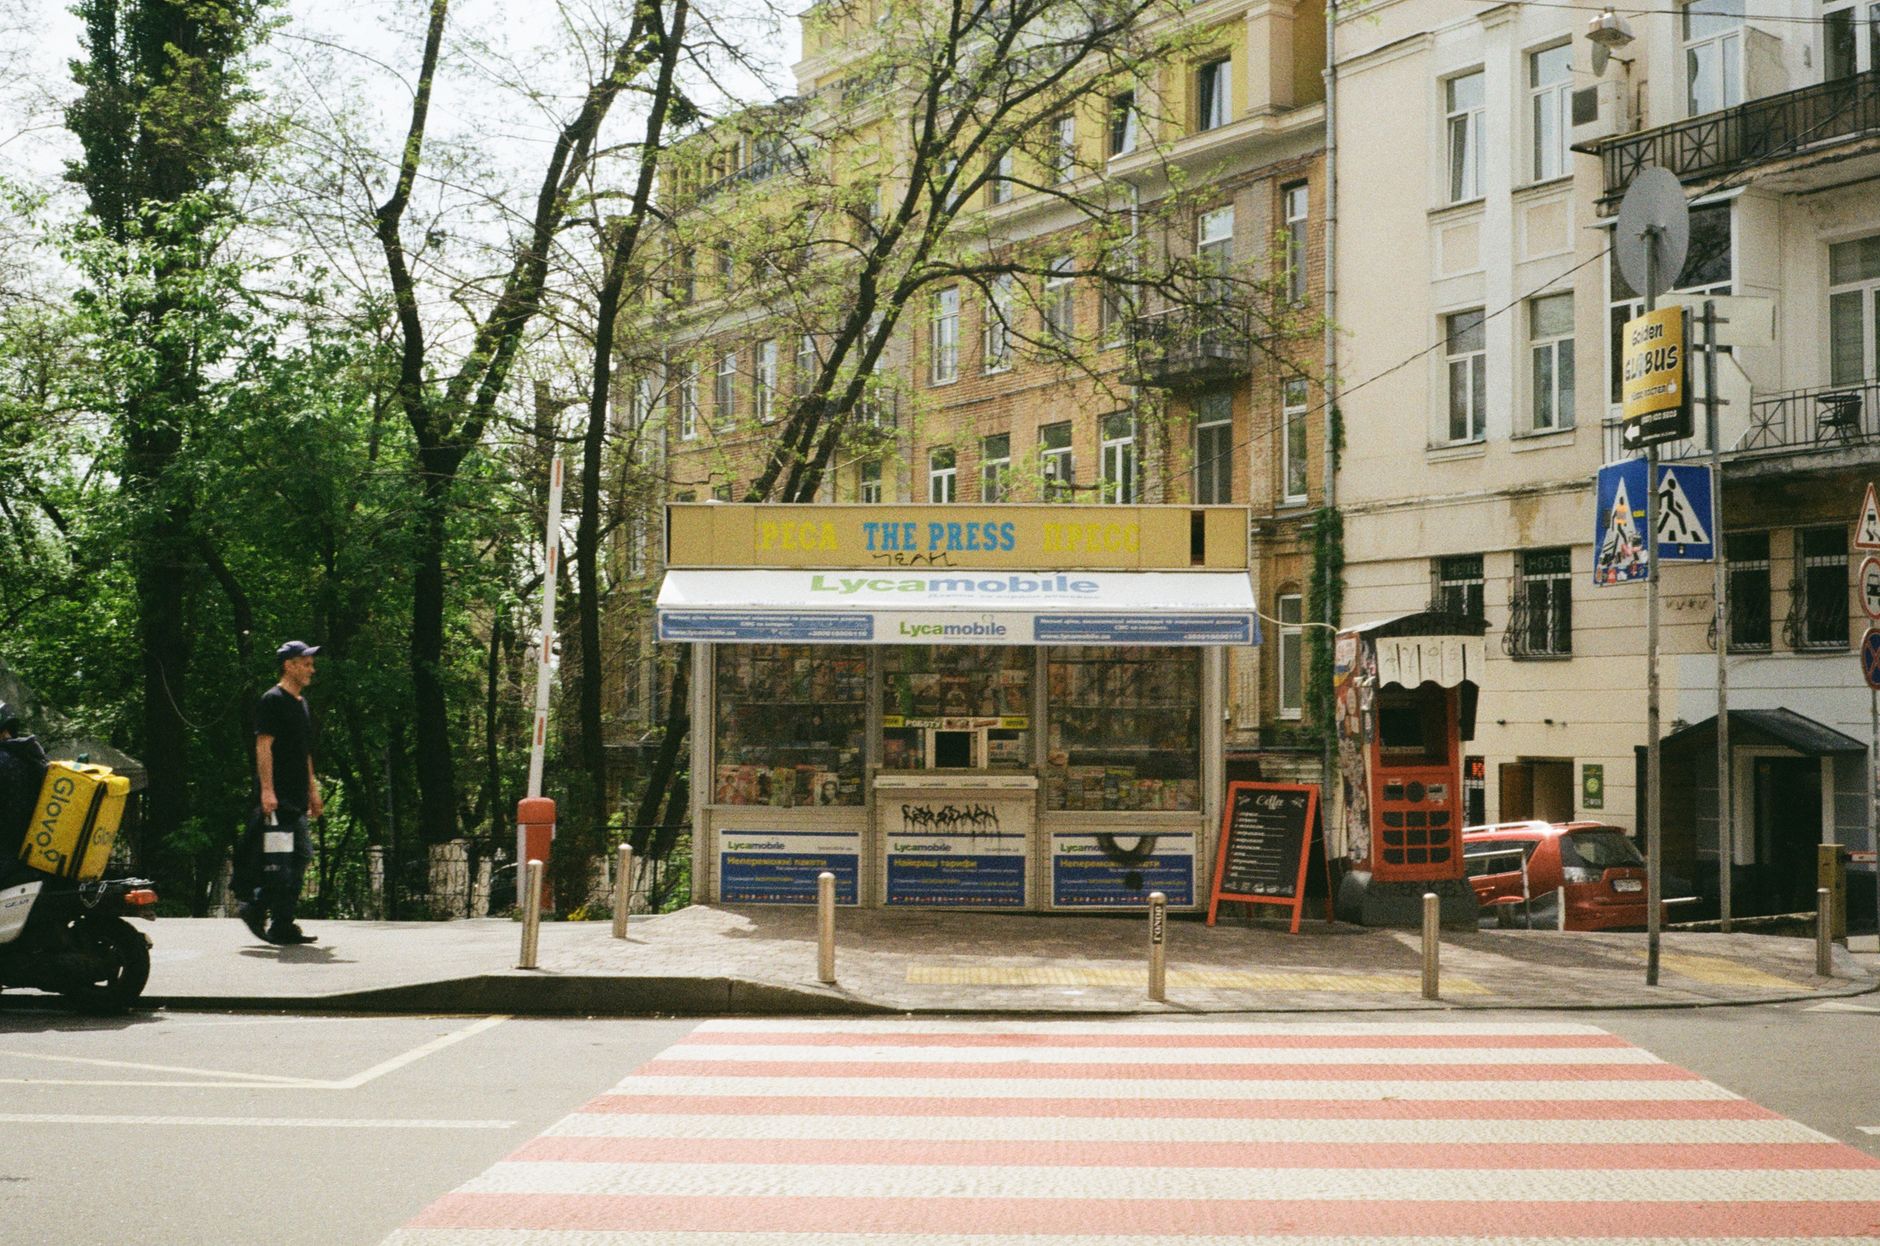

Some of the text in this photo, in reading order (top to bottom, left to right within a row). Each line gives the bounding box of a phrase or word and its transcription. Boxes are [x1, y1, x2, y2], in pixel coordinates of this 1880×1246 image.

[1631, 323, 1663, 346] Golden
[755, 520, 839, 551] РЕСА
[863, 521, 1016, 551] THE PRESS
[1042, 522, 1140, 553] ПРЕСС
[810, 573, 1101, 595] Lycamobile
[899, 621, 1007, 637] Lycamobile
[36, 776, 75, 847] Glovo
[727, 840, 785, 851] Lycamobile
[893, 842, 952, 853] Lycamobile
